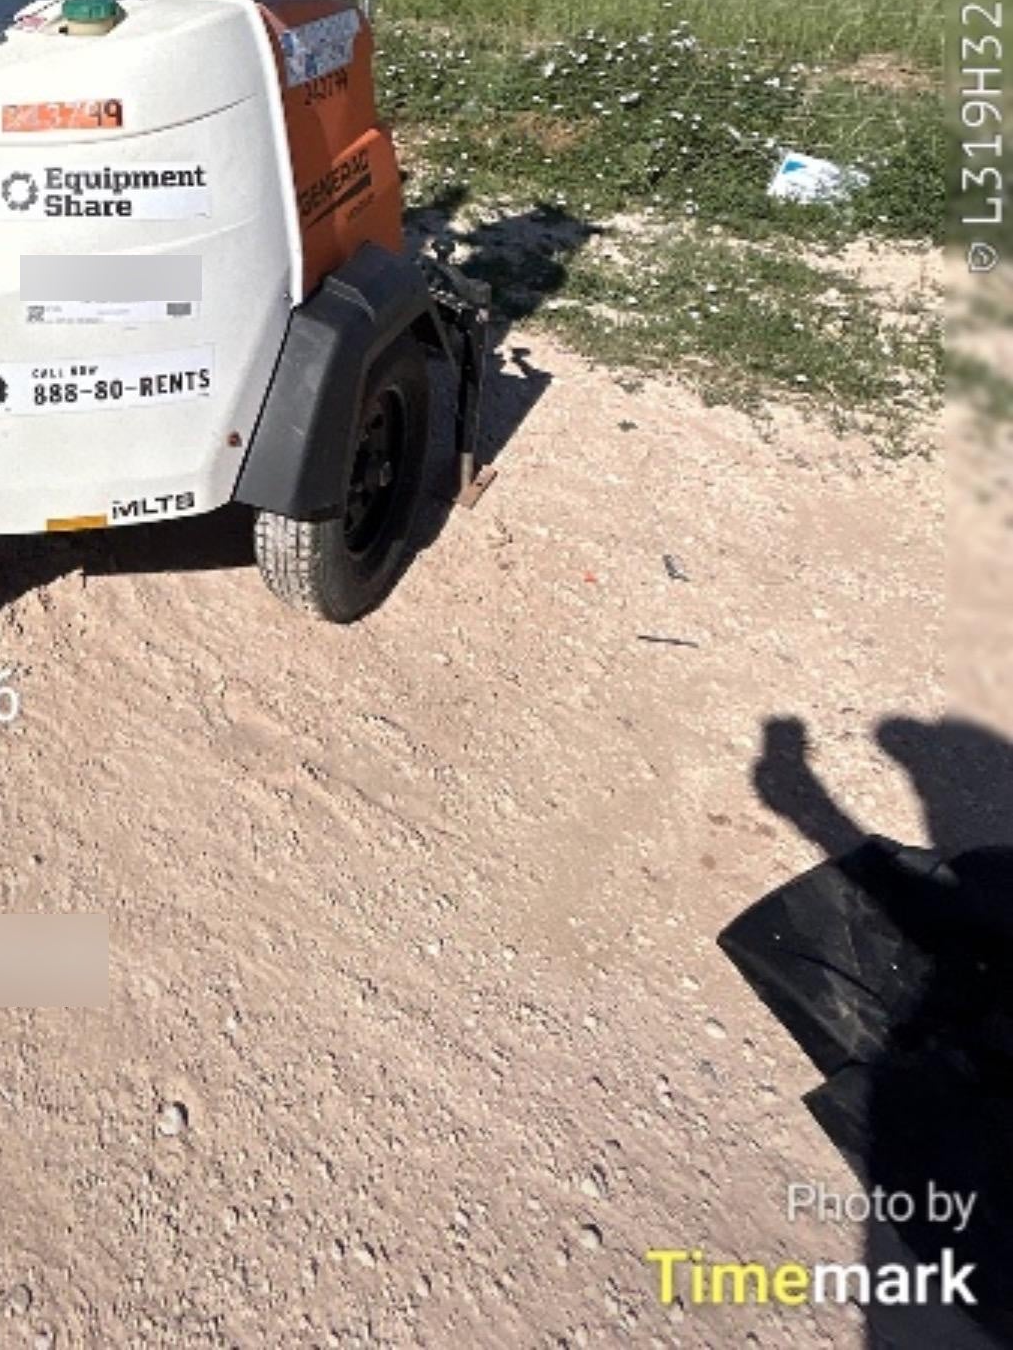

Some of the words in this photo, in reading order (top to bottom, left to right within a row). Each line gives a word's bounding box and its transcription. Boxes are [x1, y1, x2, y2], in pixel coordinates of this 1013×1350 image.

[43, 165, 207, 196] Equipment
[43, 195, 133, 218] Share
[31, 367, 64, 380] CALL
[70, 364, 99, 377] NOW
[33, 368, 211, 407] 888-80-RENTS
